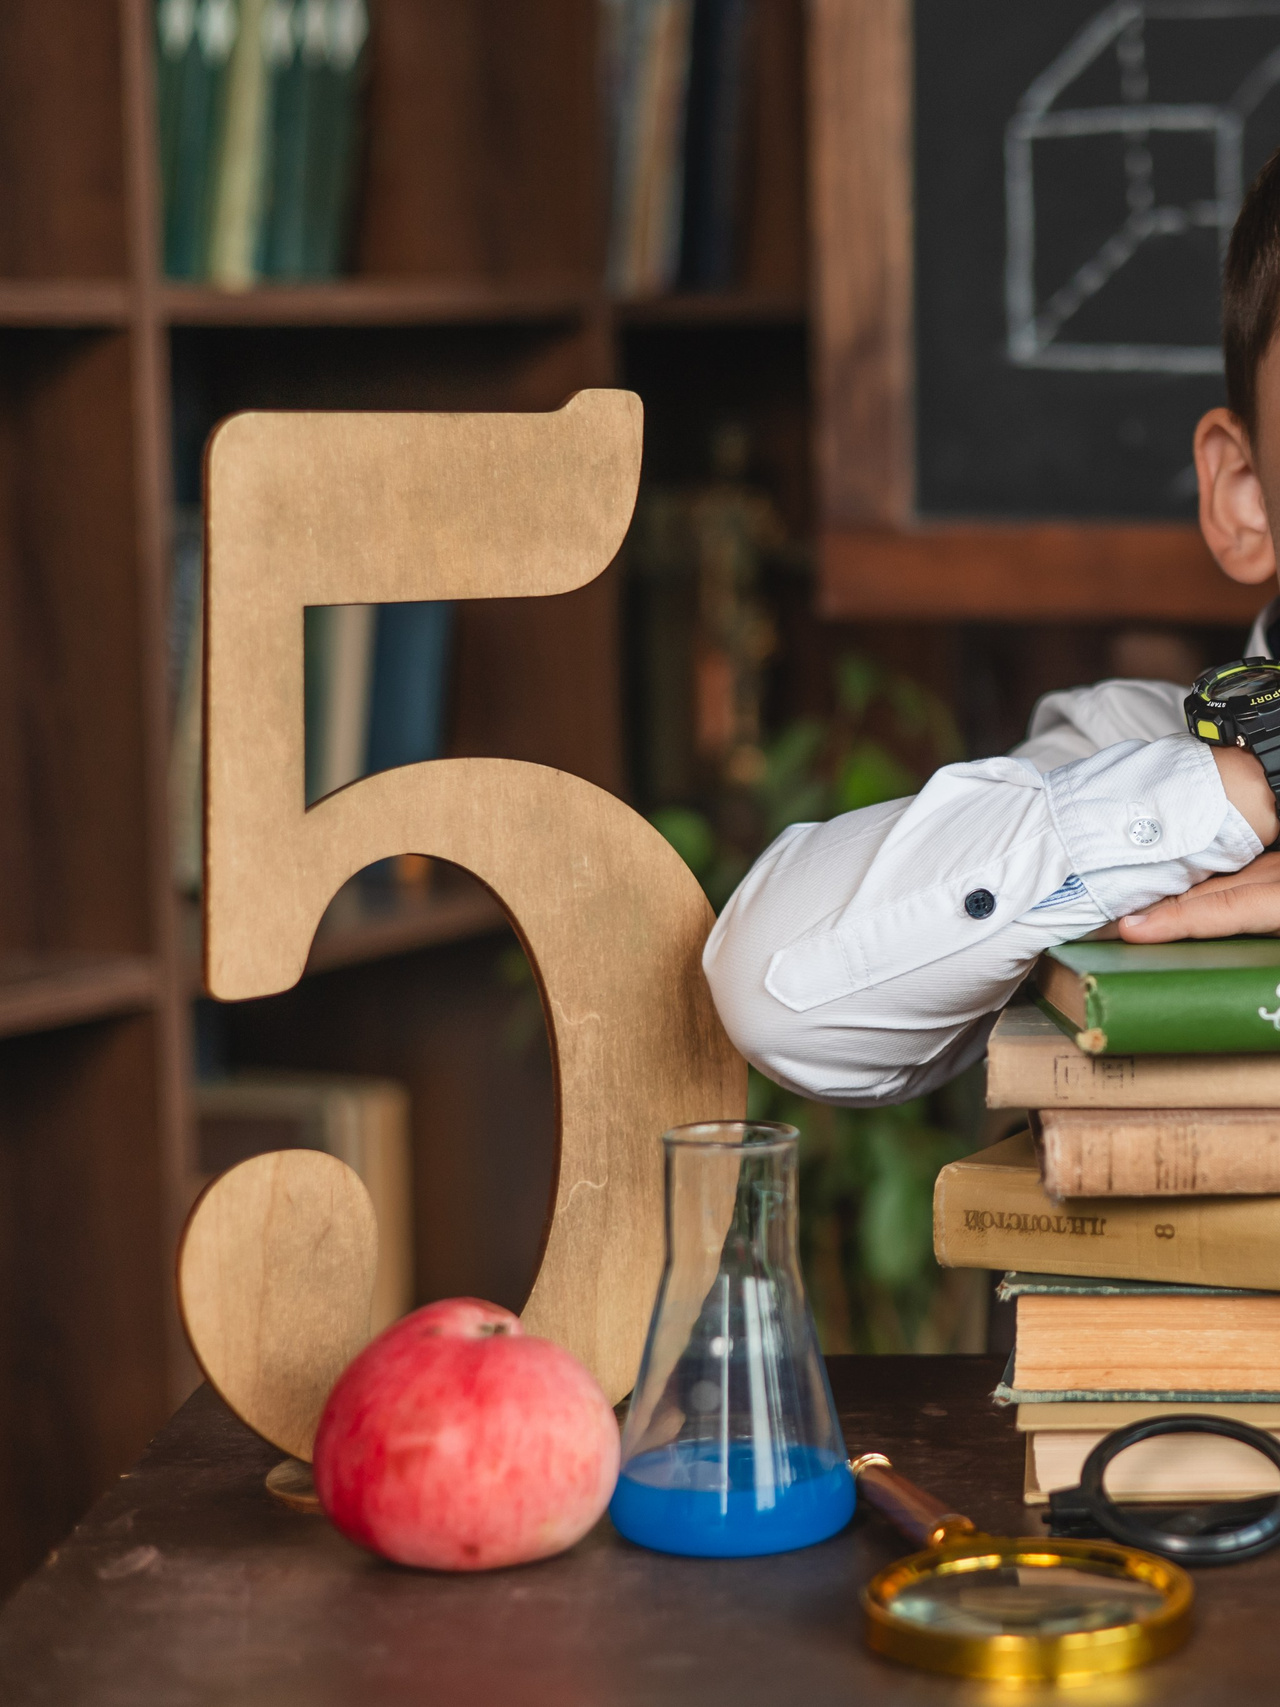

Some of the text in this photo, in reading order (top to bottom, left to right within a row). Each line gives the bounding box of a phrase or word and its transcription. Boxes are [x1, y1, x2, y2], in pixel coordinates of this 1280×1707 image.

[1206, 700, 1227, 708] START
[176, 389, 748, 1463] 5
[1154, 1223, 1176, 1240] 8
